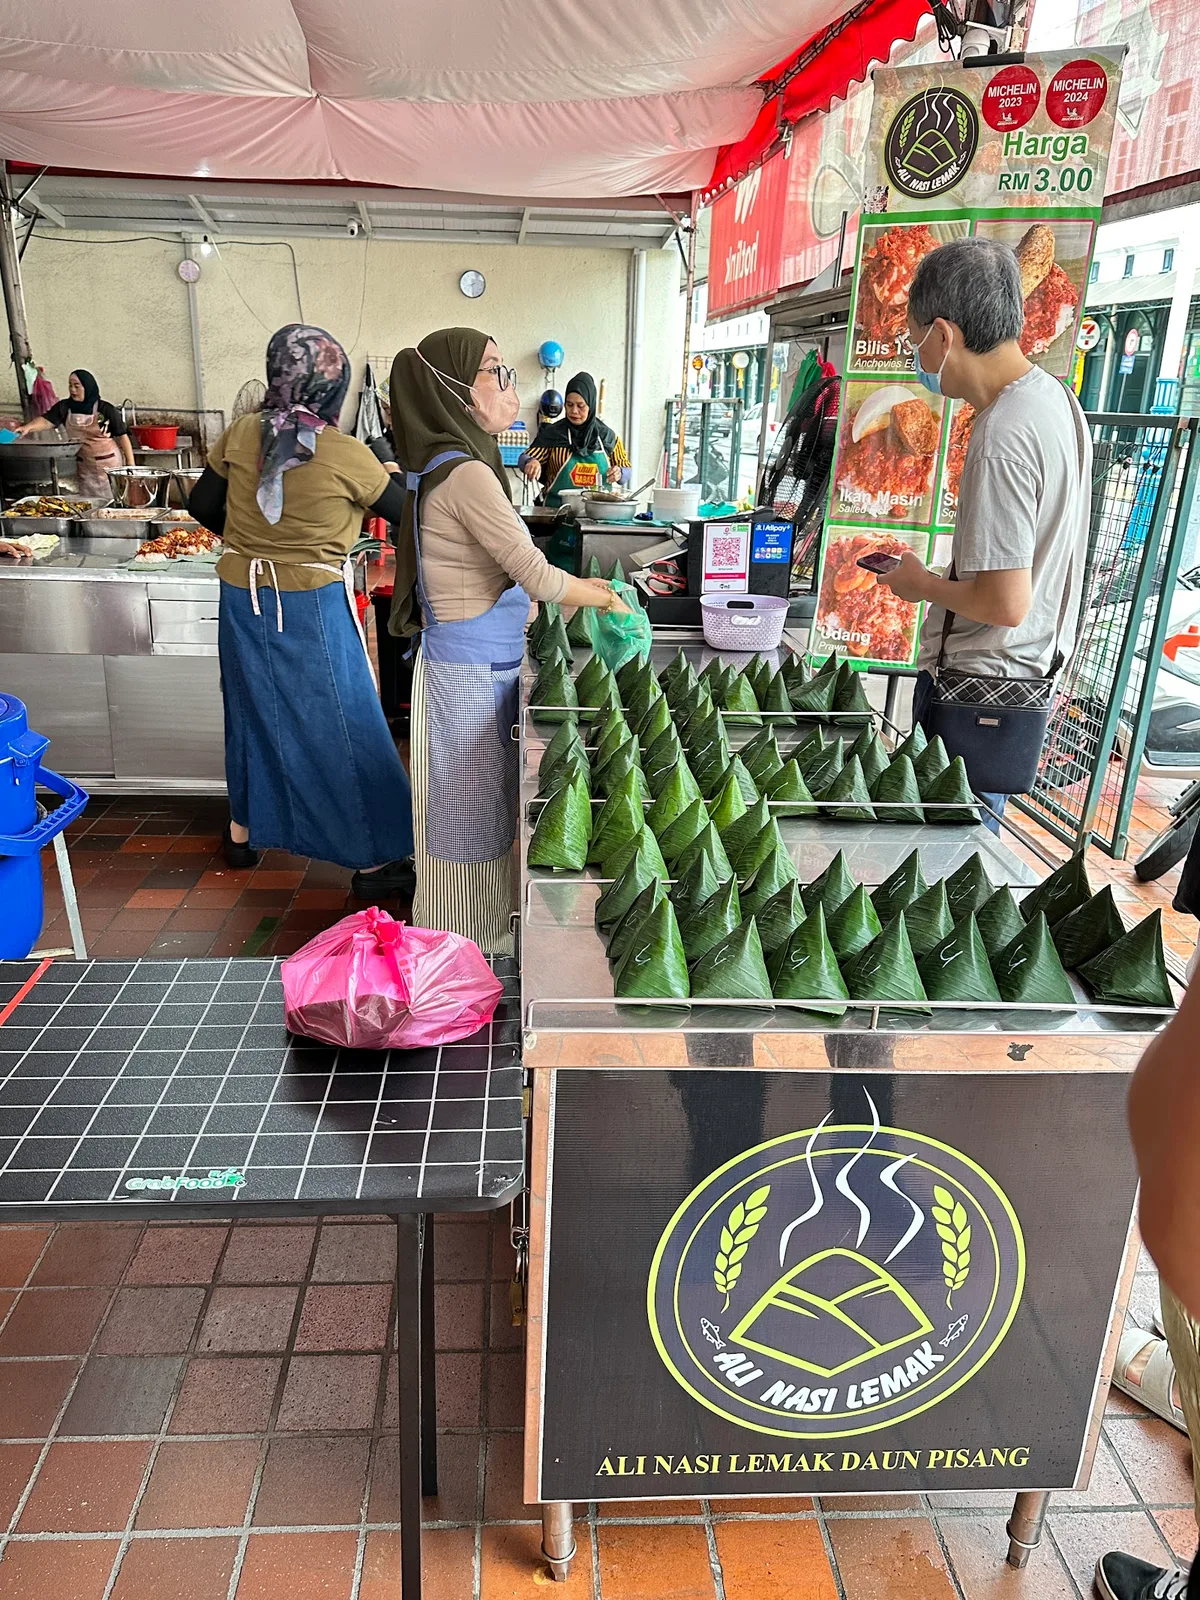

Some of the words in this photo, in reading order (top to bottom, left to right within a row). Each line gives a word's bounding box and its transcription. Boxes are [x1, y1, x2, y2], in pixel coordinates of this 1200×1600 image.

[988, 83, 1037, 98] MICHELIN
[1053, 77, 1105, 92] MICHELIN
[998, 97, 1022, 108] 2023
[1063, 92, 1089, 103] 2024
[1003, 131, 1088, 162] Harga
[897, 167, 912, 183] ALI
[908, 178, 931, 191] NASI
[930, 162, 961, 189] LEMAK
[998, 173, 1030, 191] RM
[1034, 167, 1093, 192] 3.00
[855, 340, 890, 356] Bilis
[854, 357, 903, 369] Anchovies
[839, 487, 872, 504] Ikan
[876, 490, 923, 507] Masin
[820, 626, 871, 646] Udang
[818, 641, 848, 652] Prawn
[125, 1174, 227, 1191] GrabFood
[713, 1350, 766, 1389] ALI
[758, 1379, 838, 1414] NASI
[845, 1341, 946, 1410] LEMAK
[596, 1454, 647, 1477] ALI
[652, 1453, 722, 1475] NASI
[727, 1451, 837, 1474] LEMAK
[840, 1448, 924, 1472] DAUN
[926, 1445, 1031, 1470] PISANG
